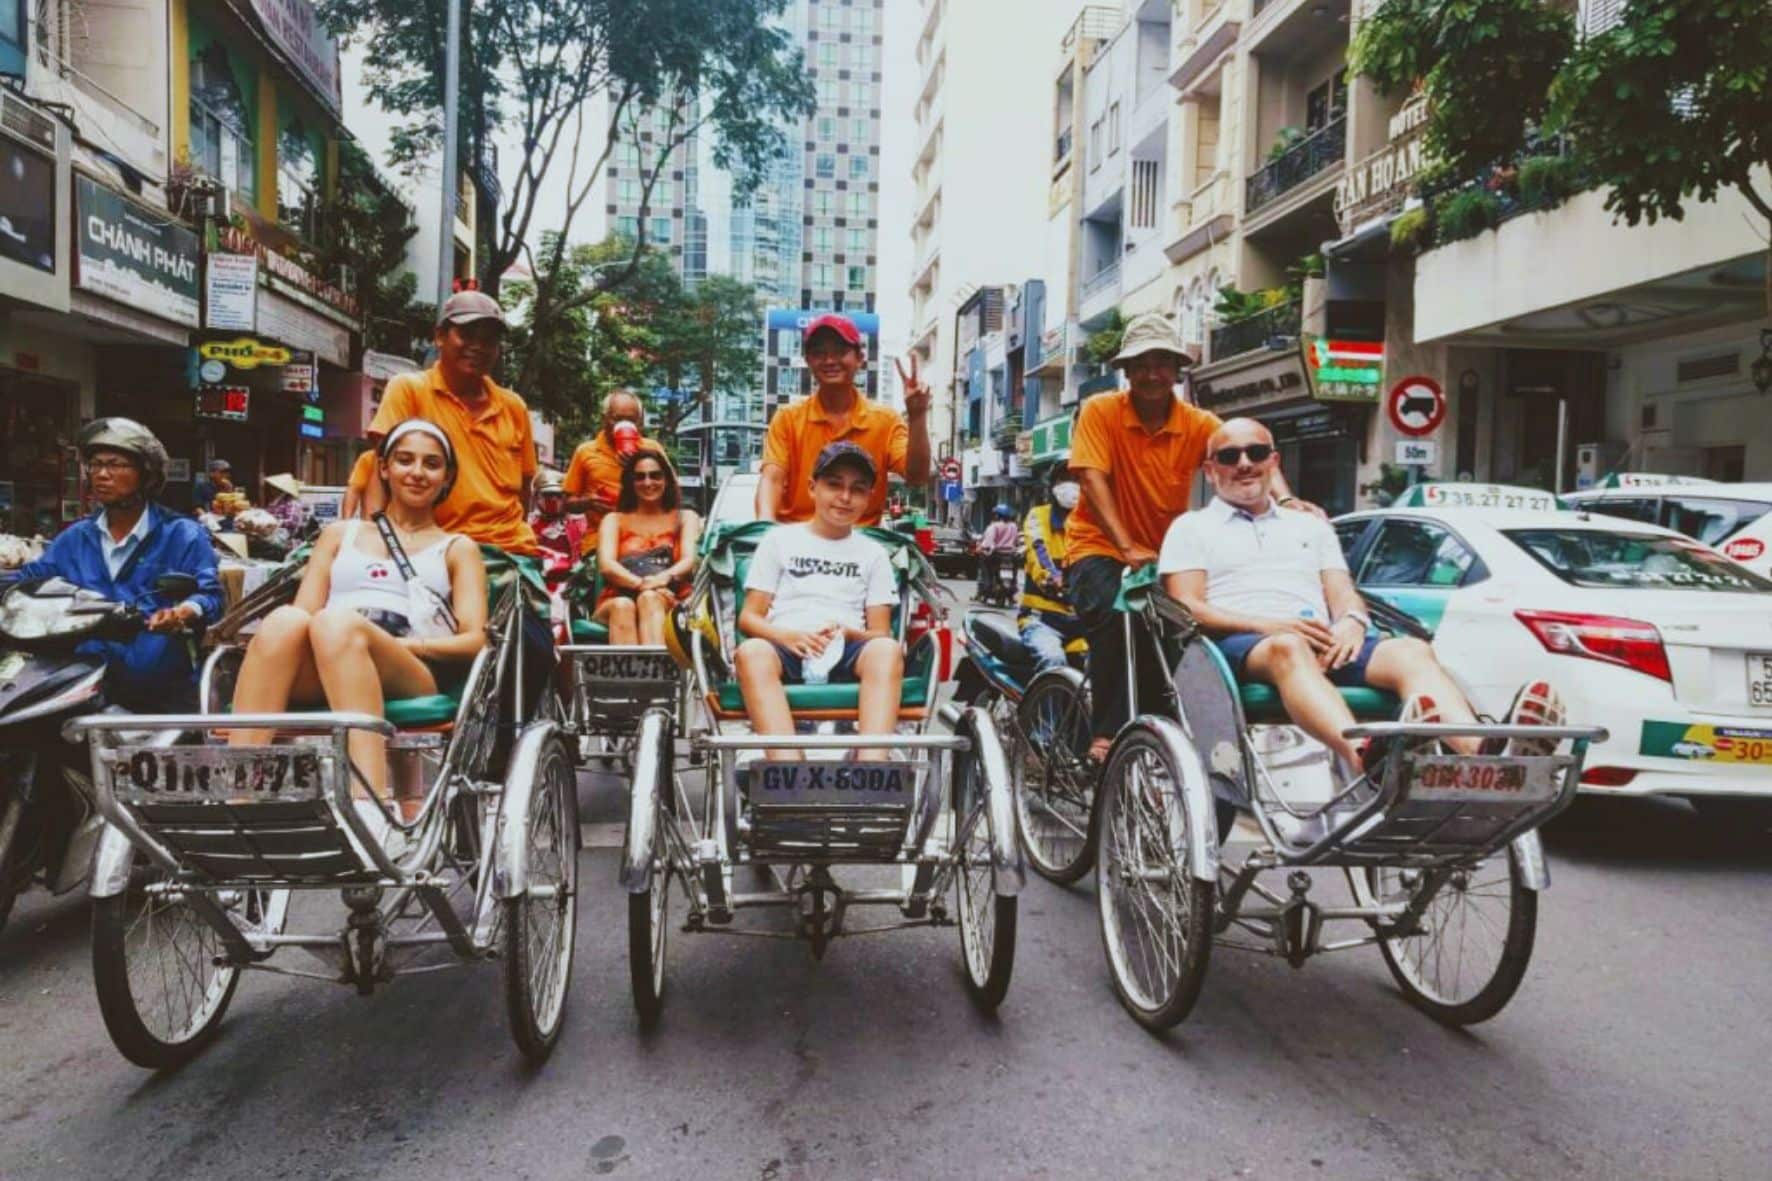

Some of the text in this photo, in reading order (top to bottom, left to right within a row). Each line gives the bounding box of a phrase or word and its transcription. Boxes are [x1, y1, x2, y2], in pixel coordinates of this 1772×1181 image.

[1371, 139, 1424, 195] HOAN
[153, 246, 195, 283] PHÁT
[1405, 446, 1427, 459] 50m
